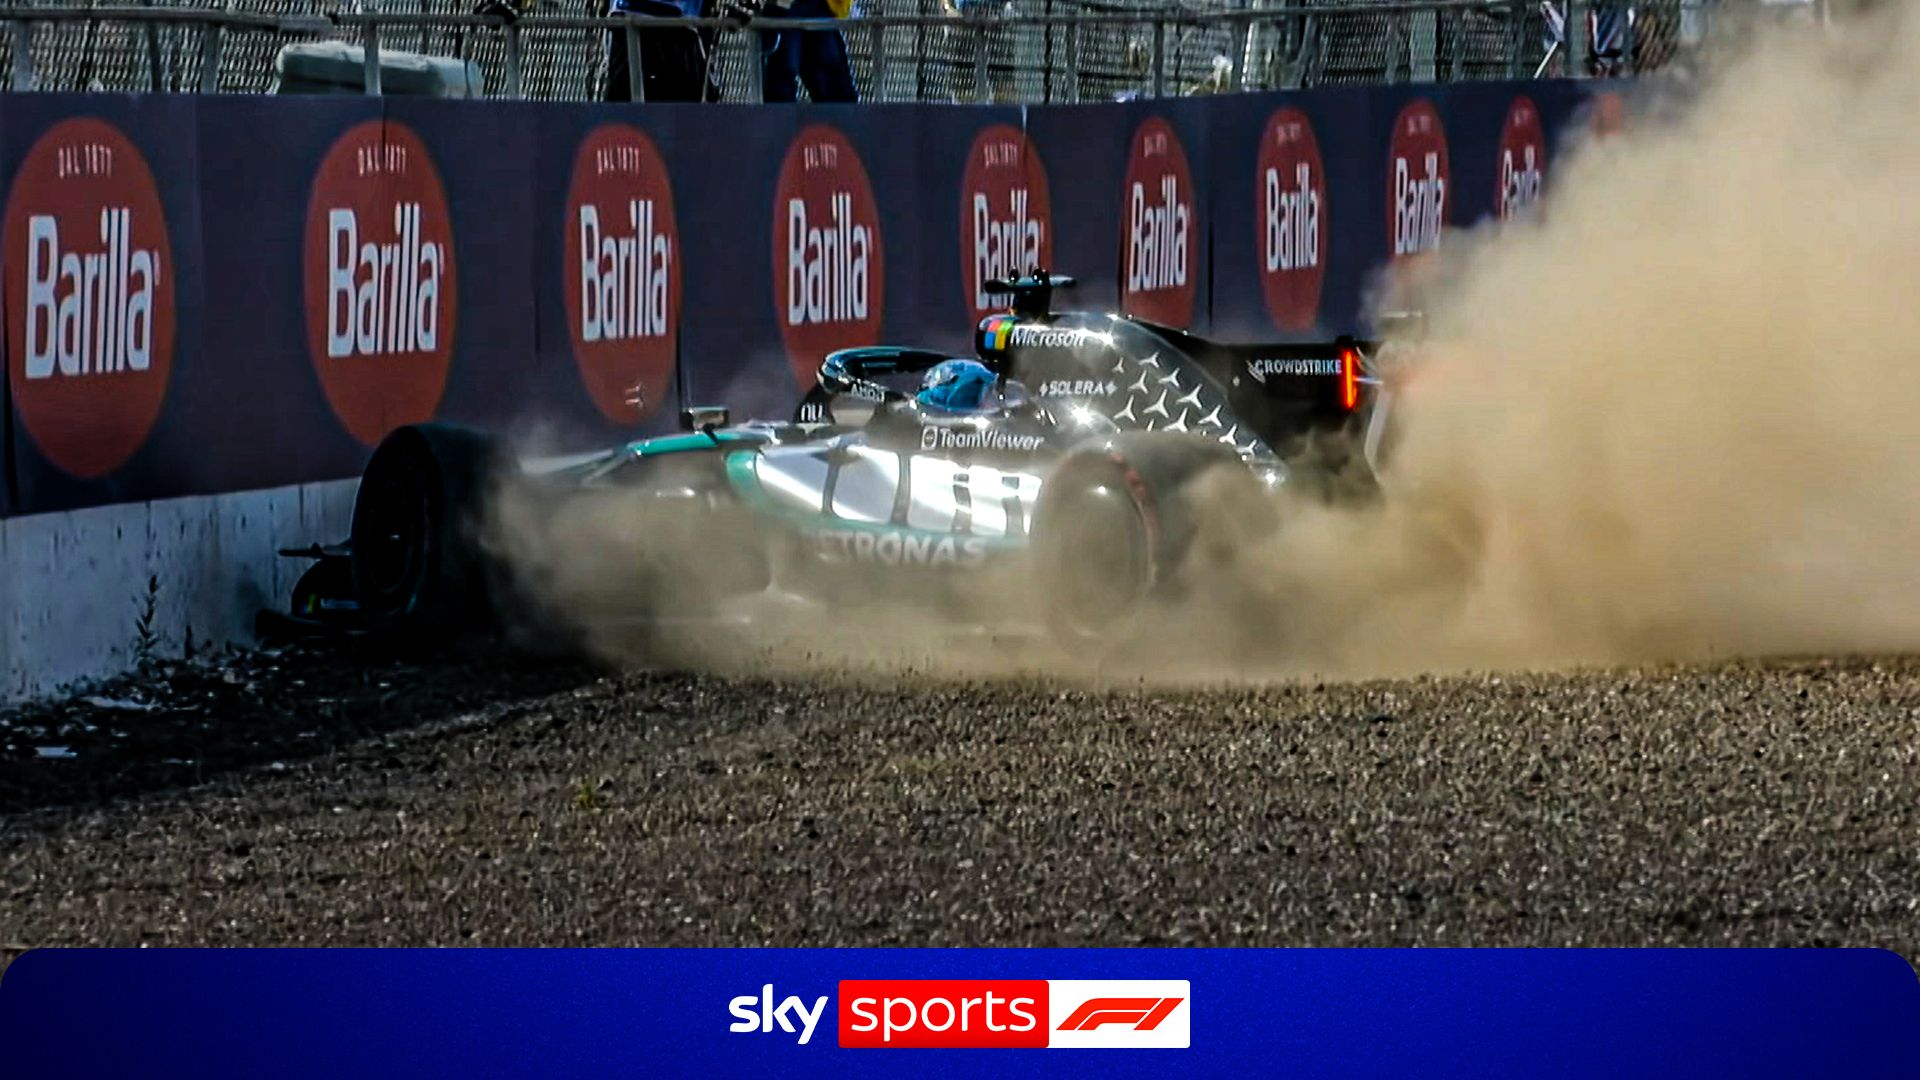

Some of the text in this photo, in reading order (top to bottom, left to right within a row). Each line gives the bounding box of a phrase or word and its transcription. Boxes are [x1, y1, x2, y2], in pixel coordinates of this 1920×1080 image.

[59, 143, 111, 178] DAL 1877
[358, 145, 379, 177] DAL
[1395, 153, 1444, 255] Barilla
[580, 200, 667, 342] Barilla
[788, 193, 868, 326] Barilla
[974, 190, 1039, 310] Barilla
[1129, 176, 1188, 293] Barilla
[1265, 163, 1319, 272] Barilla
[25, 206, 153, 379] Barilla
[328, 203, 439, 357] Barilla
[1049, 380, 1105, 396] SOLERA
[1254, 359, 1343, 375] CROWDSTRIKE
[939, 428, 1044, 450] TeamViewer
